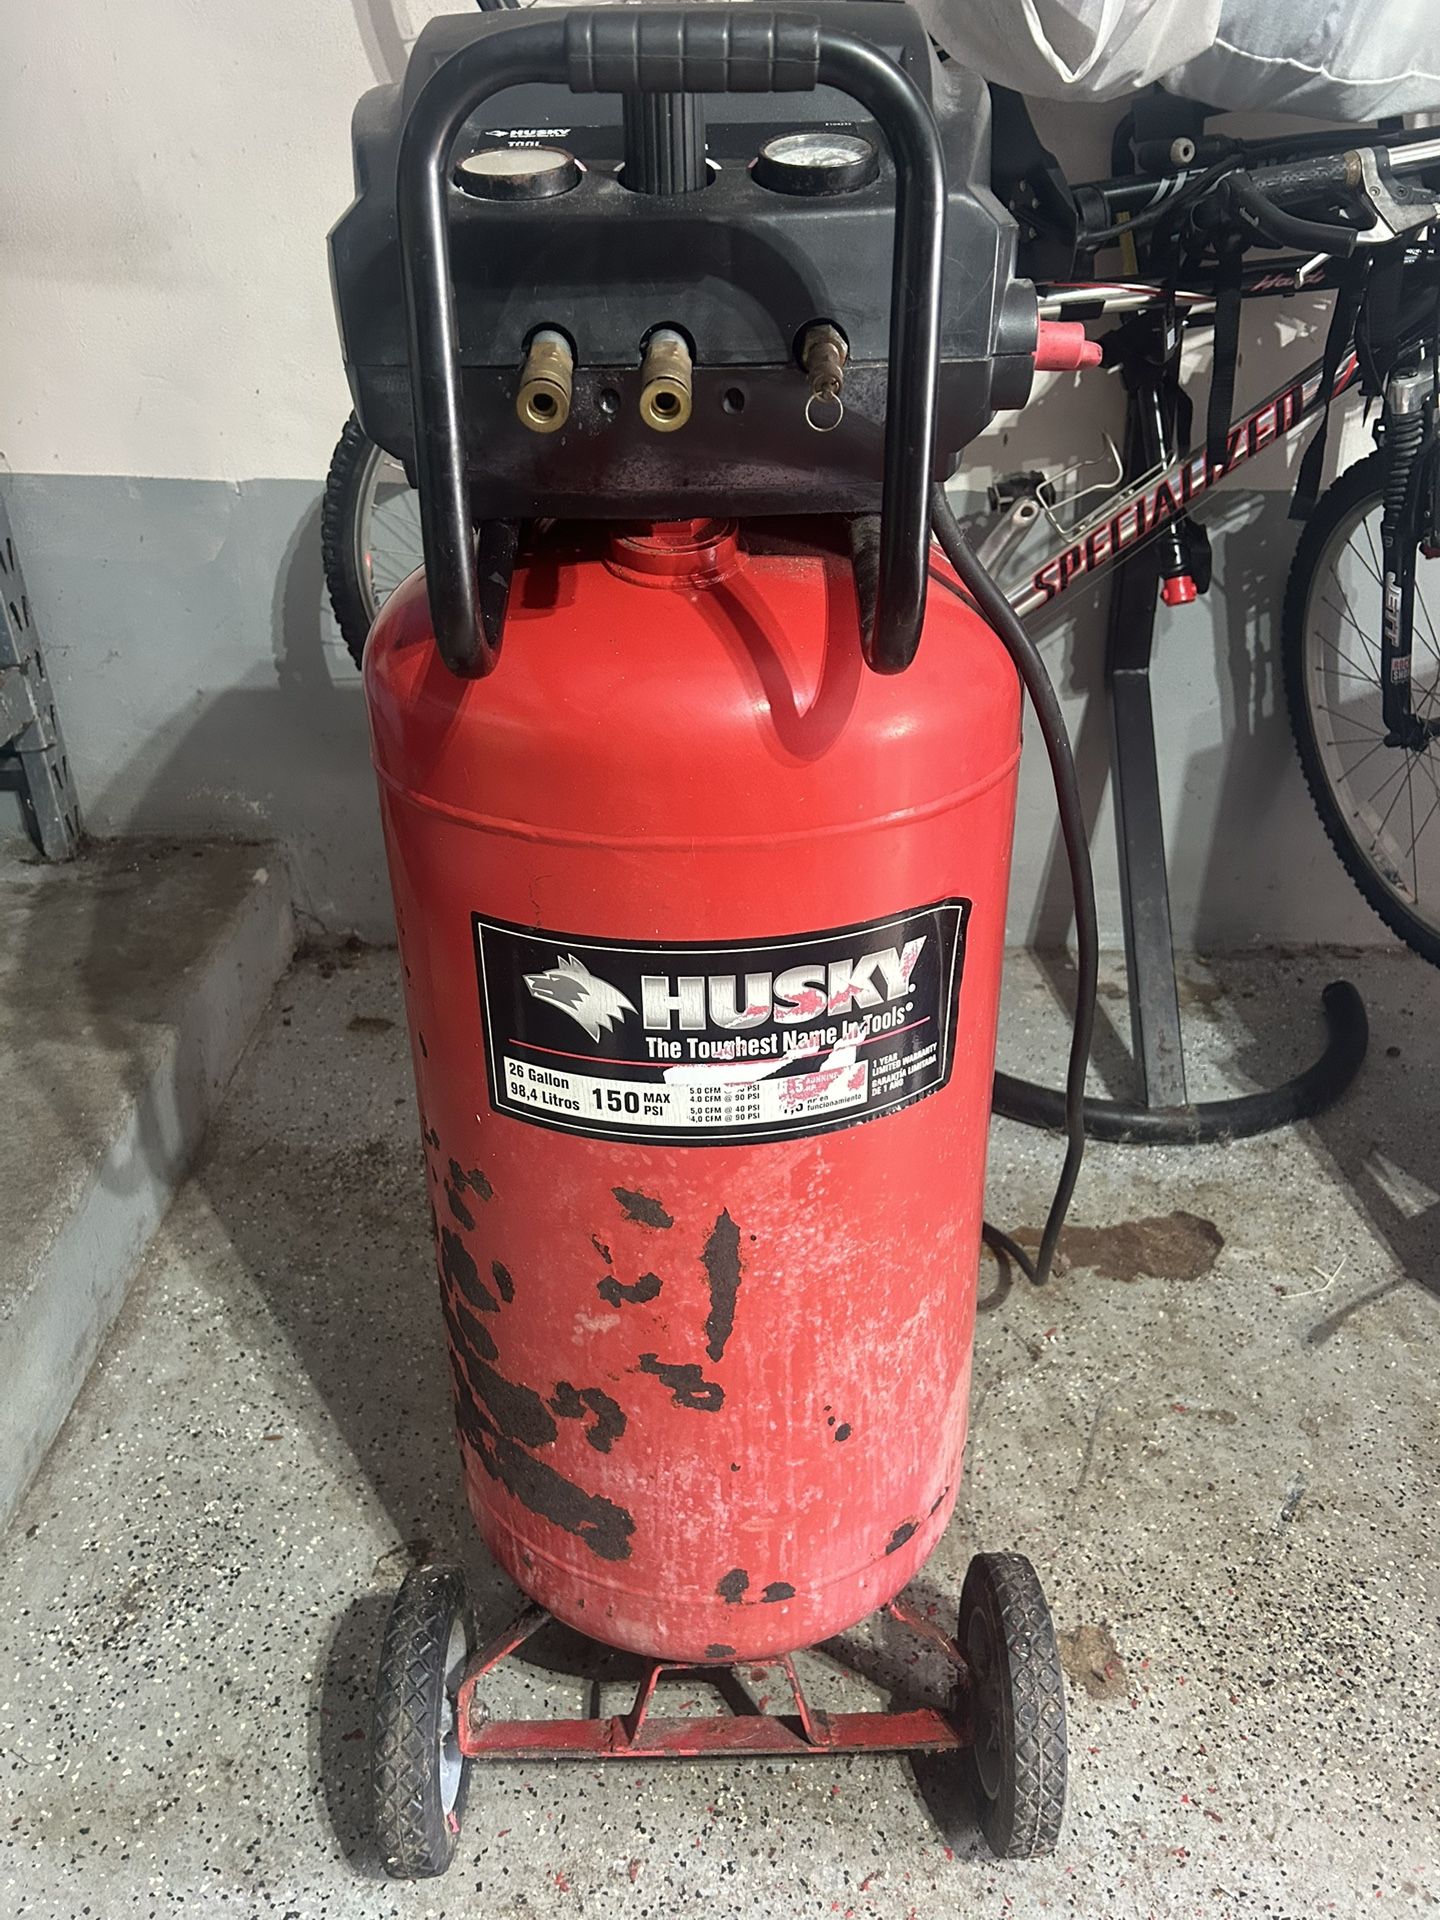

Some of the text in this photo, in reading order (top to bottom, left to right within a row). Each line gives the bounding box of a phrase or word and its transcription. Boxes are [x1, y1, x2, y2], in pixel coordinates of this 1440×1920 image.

[510, 129, 571, 138] HUSKY
[646, 1037, 682, 1058] The
[687, 1033, 778, 1060] Toughest
[783, 1026, 837, 1050] Name
[872, 1042, 937, 1076] LIMITED WARRANTY
[879, 1052, 898, 1066] YEAR
[908, 1054, 937, 1075] LIMITADA
[509, 1062, 569, 1089] 26 Gallon
[511, 1082, 580, 1111] 98,4 Litros
[593, 1088, 670, 1113] 150 MAX
[872, 1088, 881, 1096] DE
[645, 1106, 663, 1116] PSI
[690, 1107, 703, 1115] 5,0
[725, 1106, 733, 1114] @
[807, 1094, 862, 1111] funcionamiento
